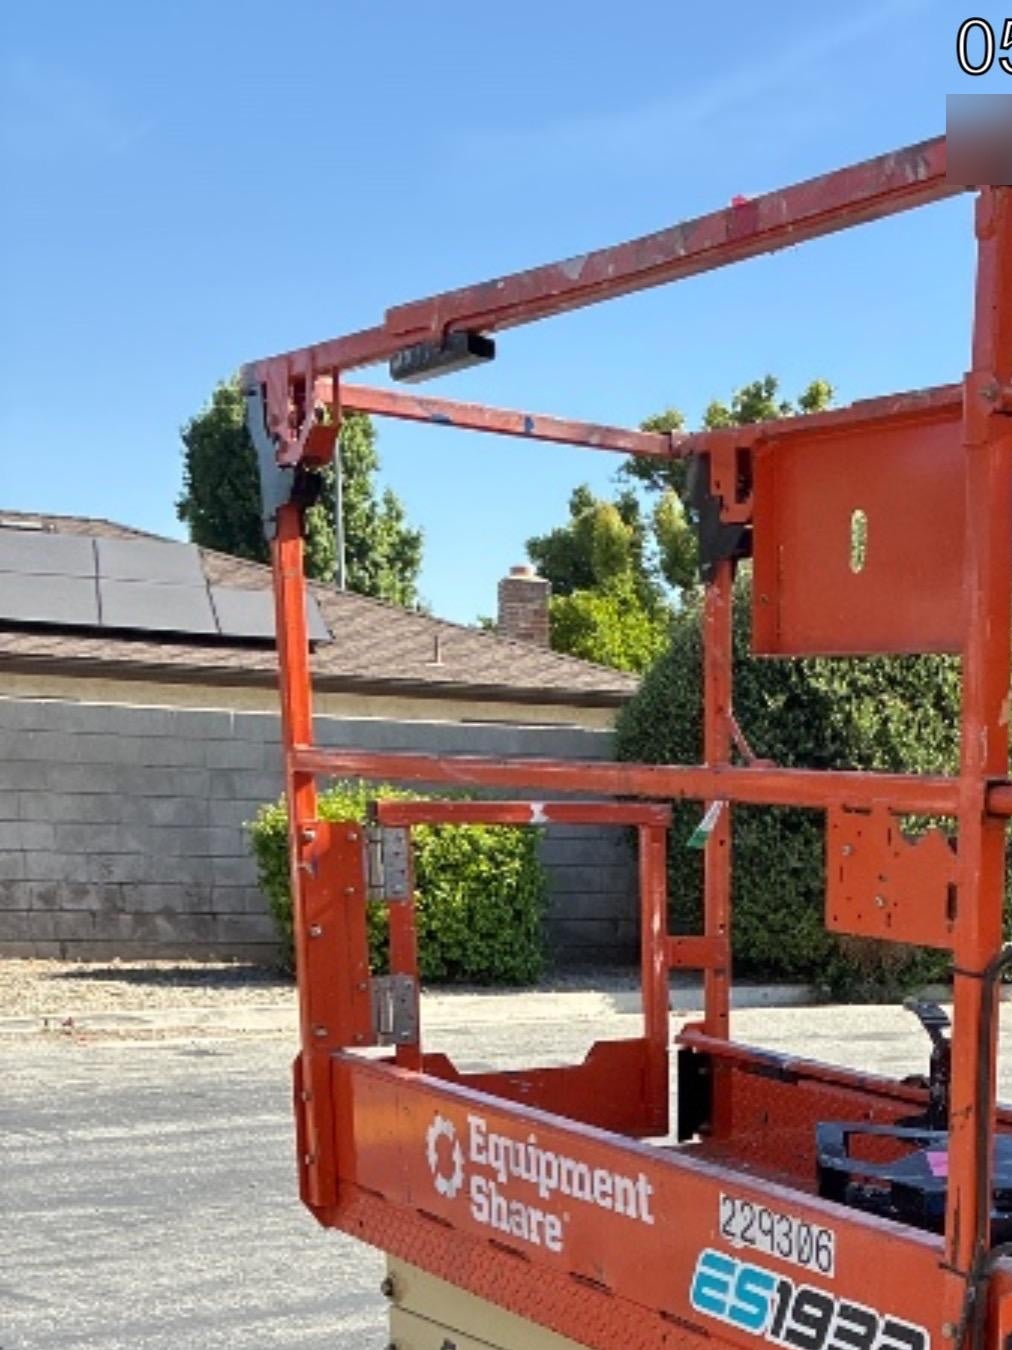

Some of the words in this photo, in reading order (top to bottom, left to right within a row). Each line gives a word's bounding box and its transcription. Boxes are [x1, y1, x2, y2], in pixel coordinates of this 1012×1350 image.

[467, 1115, 654, 1224] Equipment
[470, 1175, 563, 1252] Share
[722, 1196, 833, 1272] 229306
